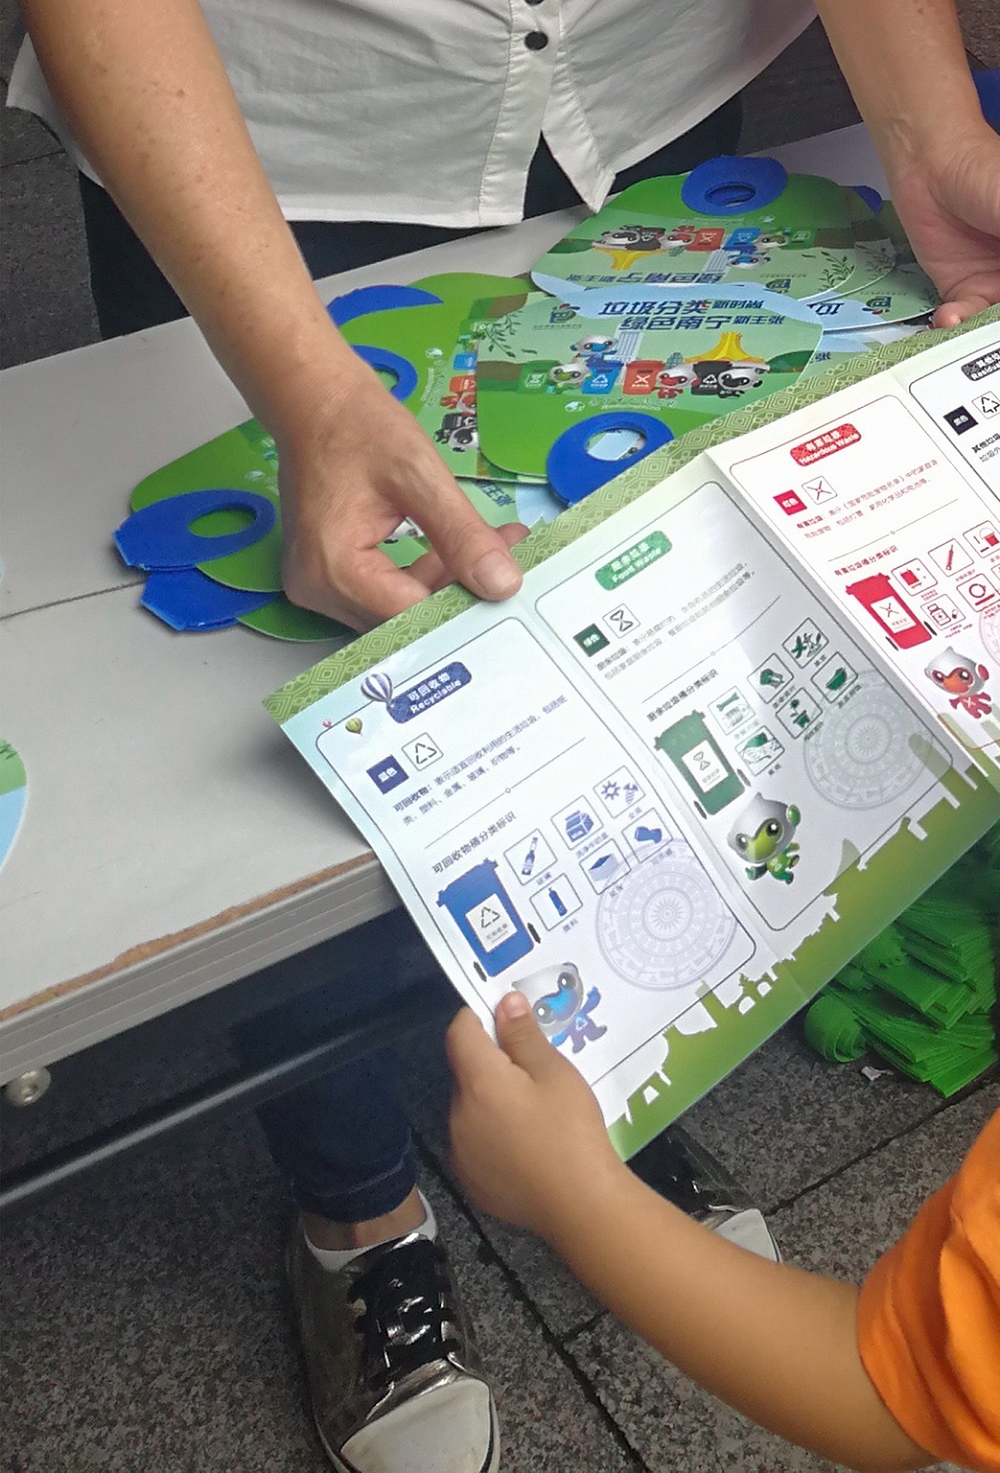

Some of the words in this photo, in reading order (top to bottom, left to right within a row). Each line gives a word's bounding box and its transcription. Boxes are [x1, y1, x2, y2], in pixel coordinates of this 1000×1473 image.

[407, 672, 451, 701] 可回收物
[410, 679, 462, 714] Recyclable
